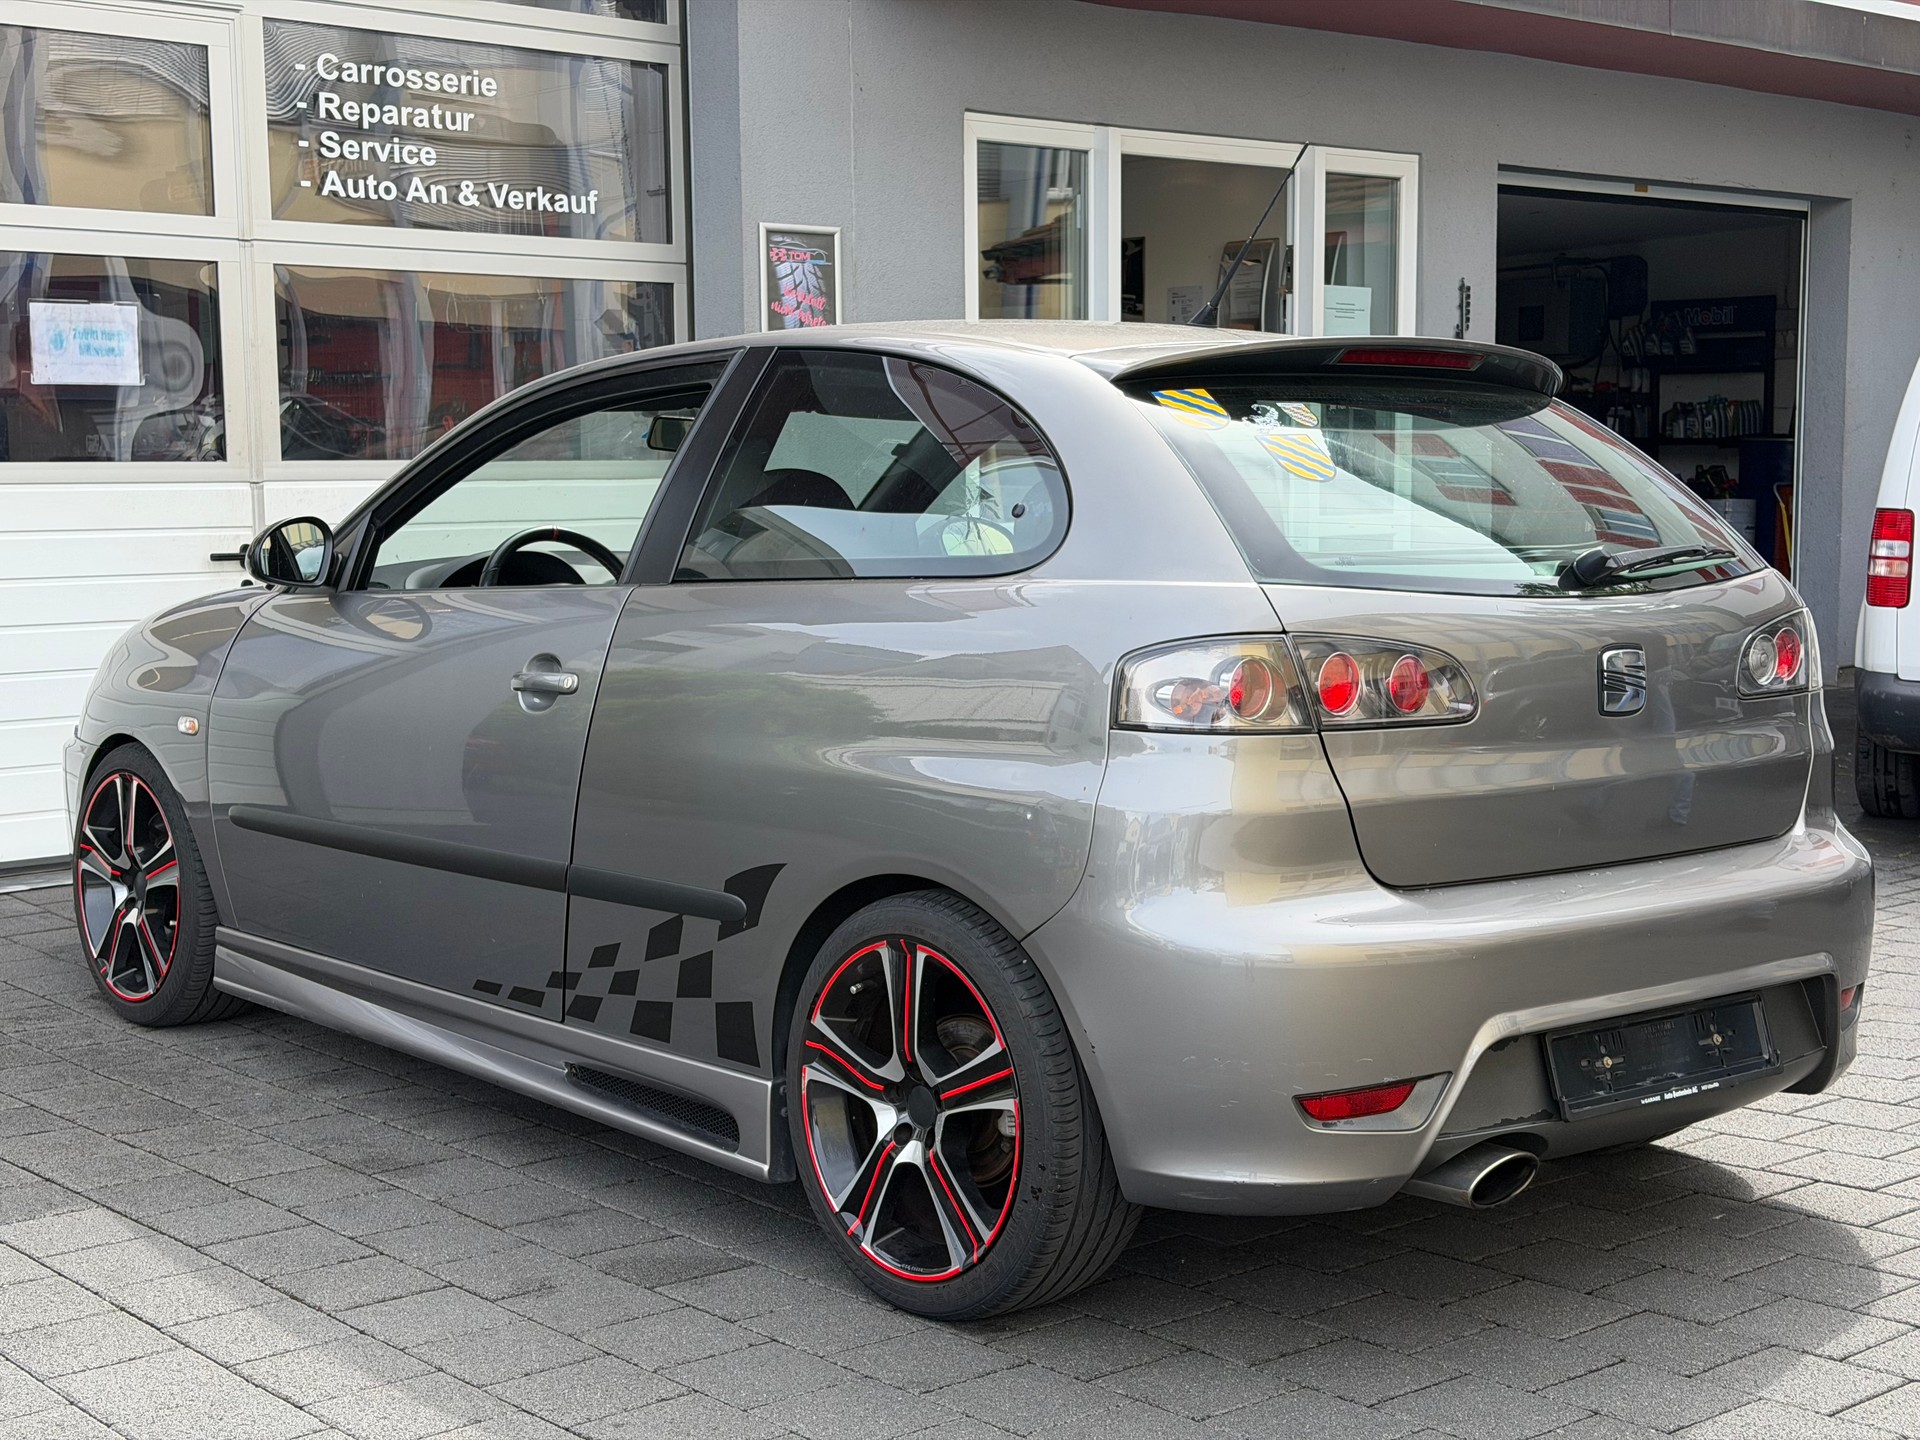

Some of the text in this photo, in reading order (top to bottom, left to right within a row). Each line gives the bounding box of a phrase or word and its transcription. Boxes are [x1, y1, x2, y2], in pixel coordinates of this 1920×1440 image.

[316, 52, 498, 97] Carrosserie
[318, 91, 475, 132] Reparatur
[319, 130, 437, 167] Service
[321, 169, 398, 202] Auto
[405, 176, 448, 205] An
[458, 180, 480, 208] &
[487, 181, 599, 215] Verkauf
[1684, 306, 1733, 326] Mobil
